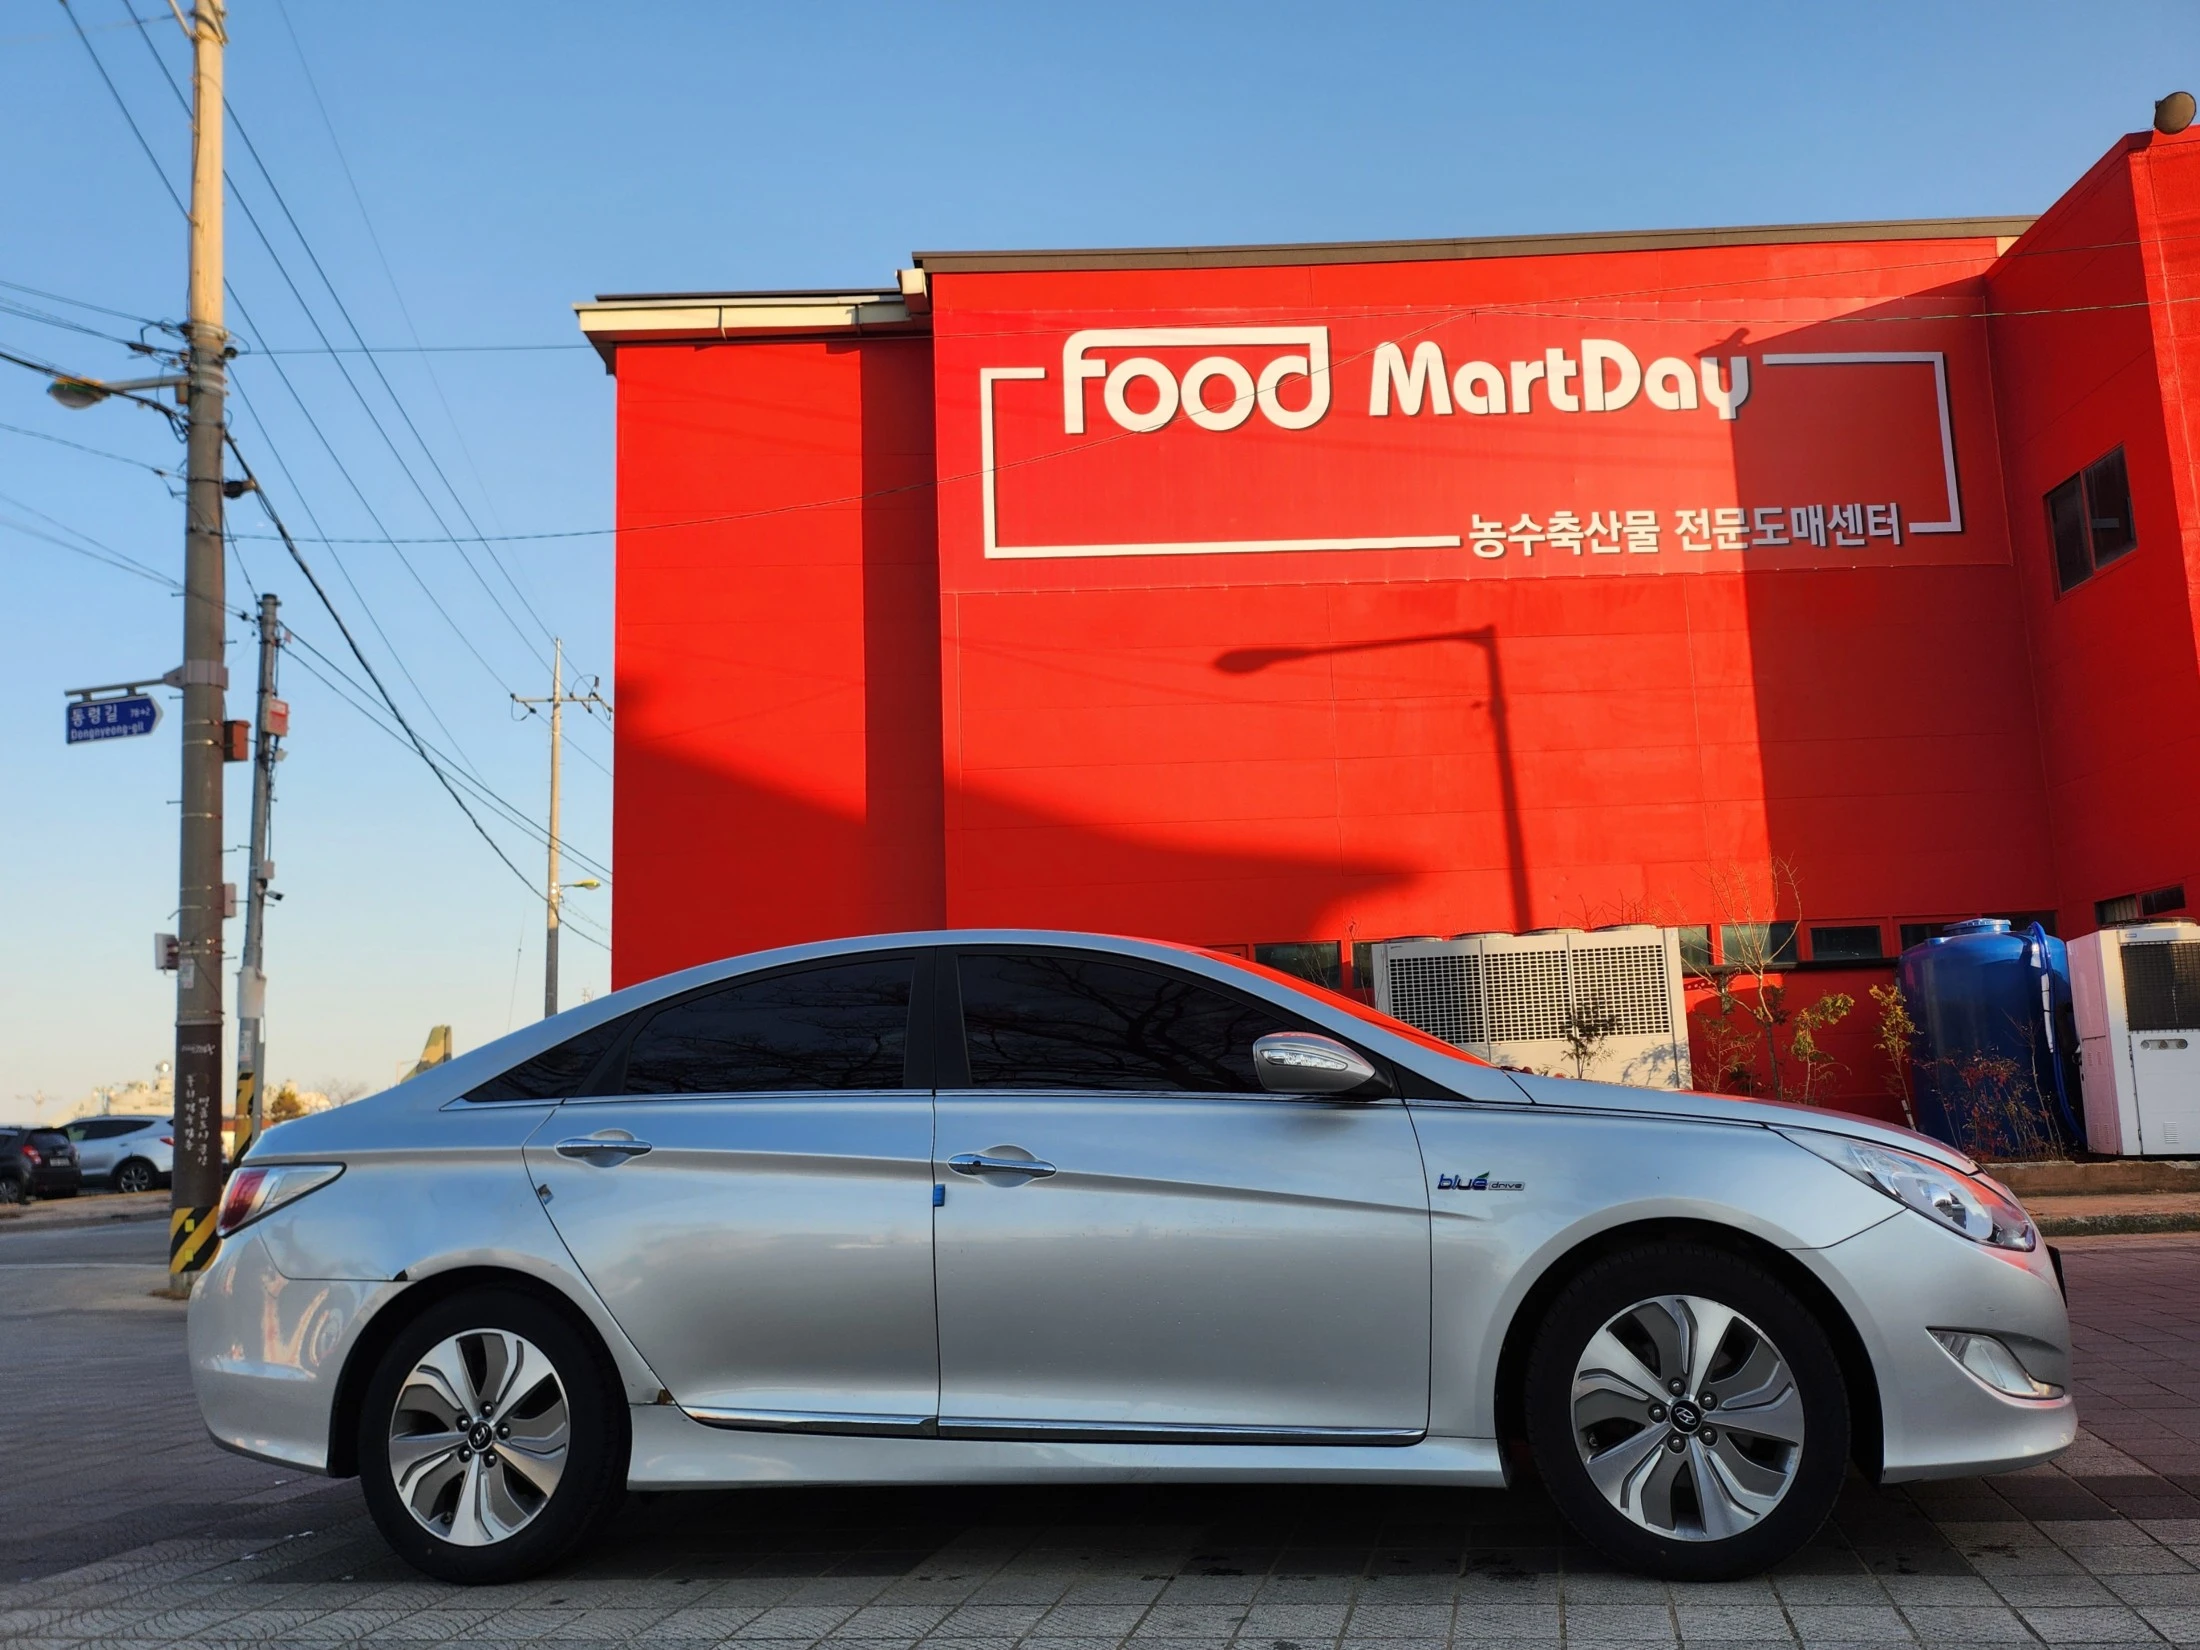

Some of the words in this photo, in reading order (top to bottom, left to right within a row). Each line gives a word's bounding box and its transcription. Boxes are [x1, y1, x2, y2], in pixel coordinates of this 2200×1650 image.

[1369, 338, 1751, 421] MartDay
[1468, 510, 1660, 558] 농수축산물
[1674, 502, 1901, 551] 전문도매센터
[71, 721, 144, 740] Dongnyeong-gil
